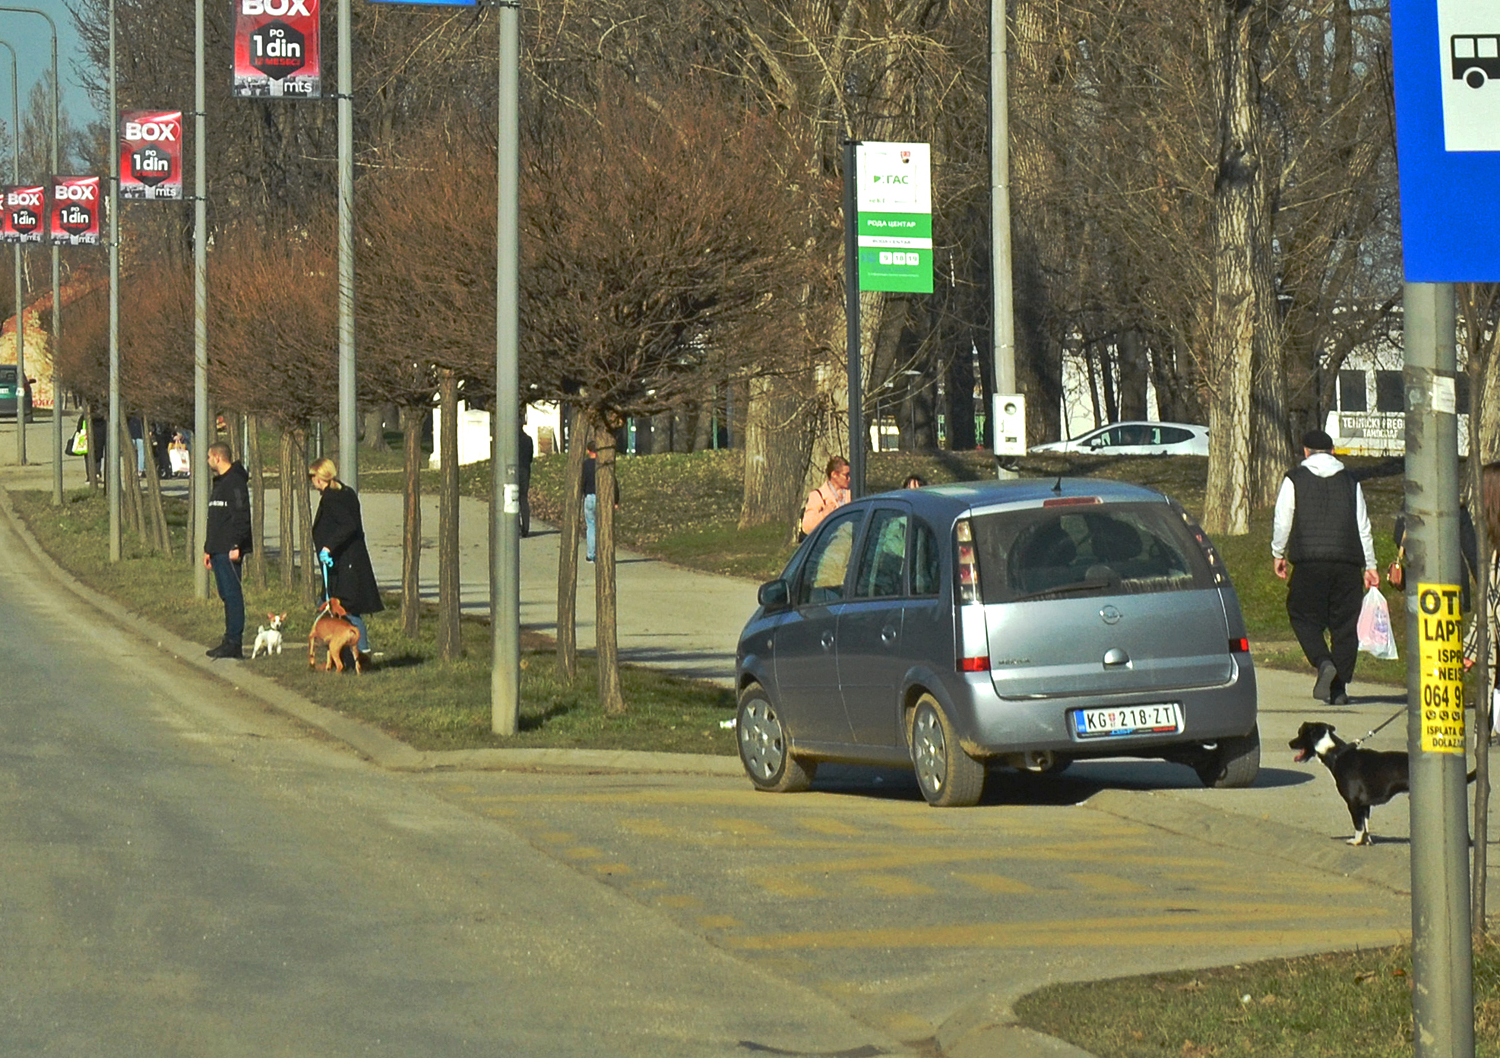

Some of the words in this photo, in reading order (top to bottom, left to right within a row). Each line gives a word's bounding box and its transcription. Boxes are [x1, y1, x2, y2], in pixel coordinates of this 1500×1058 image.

[269, 29, 284, 37] PO
[253, 35, 263, 56] 1
[266, 38, 300, 57] din
[284, 81, 312, 92] mts
[125, 122, 175, 141] BOX
[133, 154, 141, 170] 1
[143, 156, 168, 171] din
[55, 185, 94, 200] BOX
[156, 186, 176, 196] mts
[8, 193, 40, 206] BOX
[13, 213, 18, 224] 1
[19, 215, 35, 224] din
[61, 210, 68, 223] 1
[69, 212, 88, 223] din
[1420, 589, 1462, 615] OT
[1424, 684, 1449, 707] 064
[1086, 712, 1107, 729] KG
